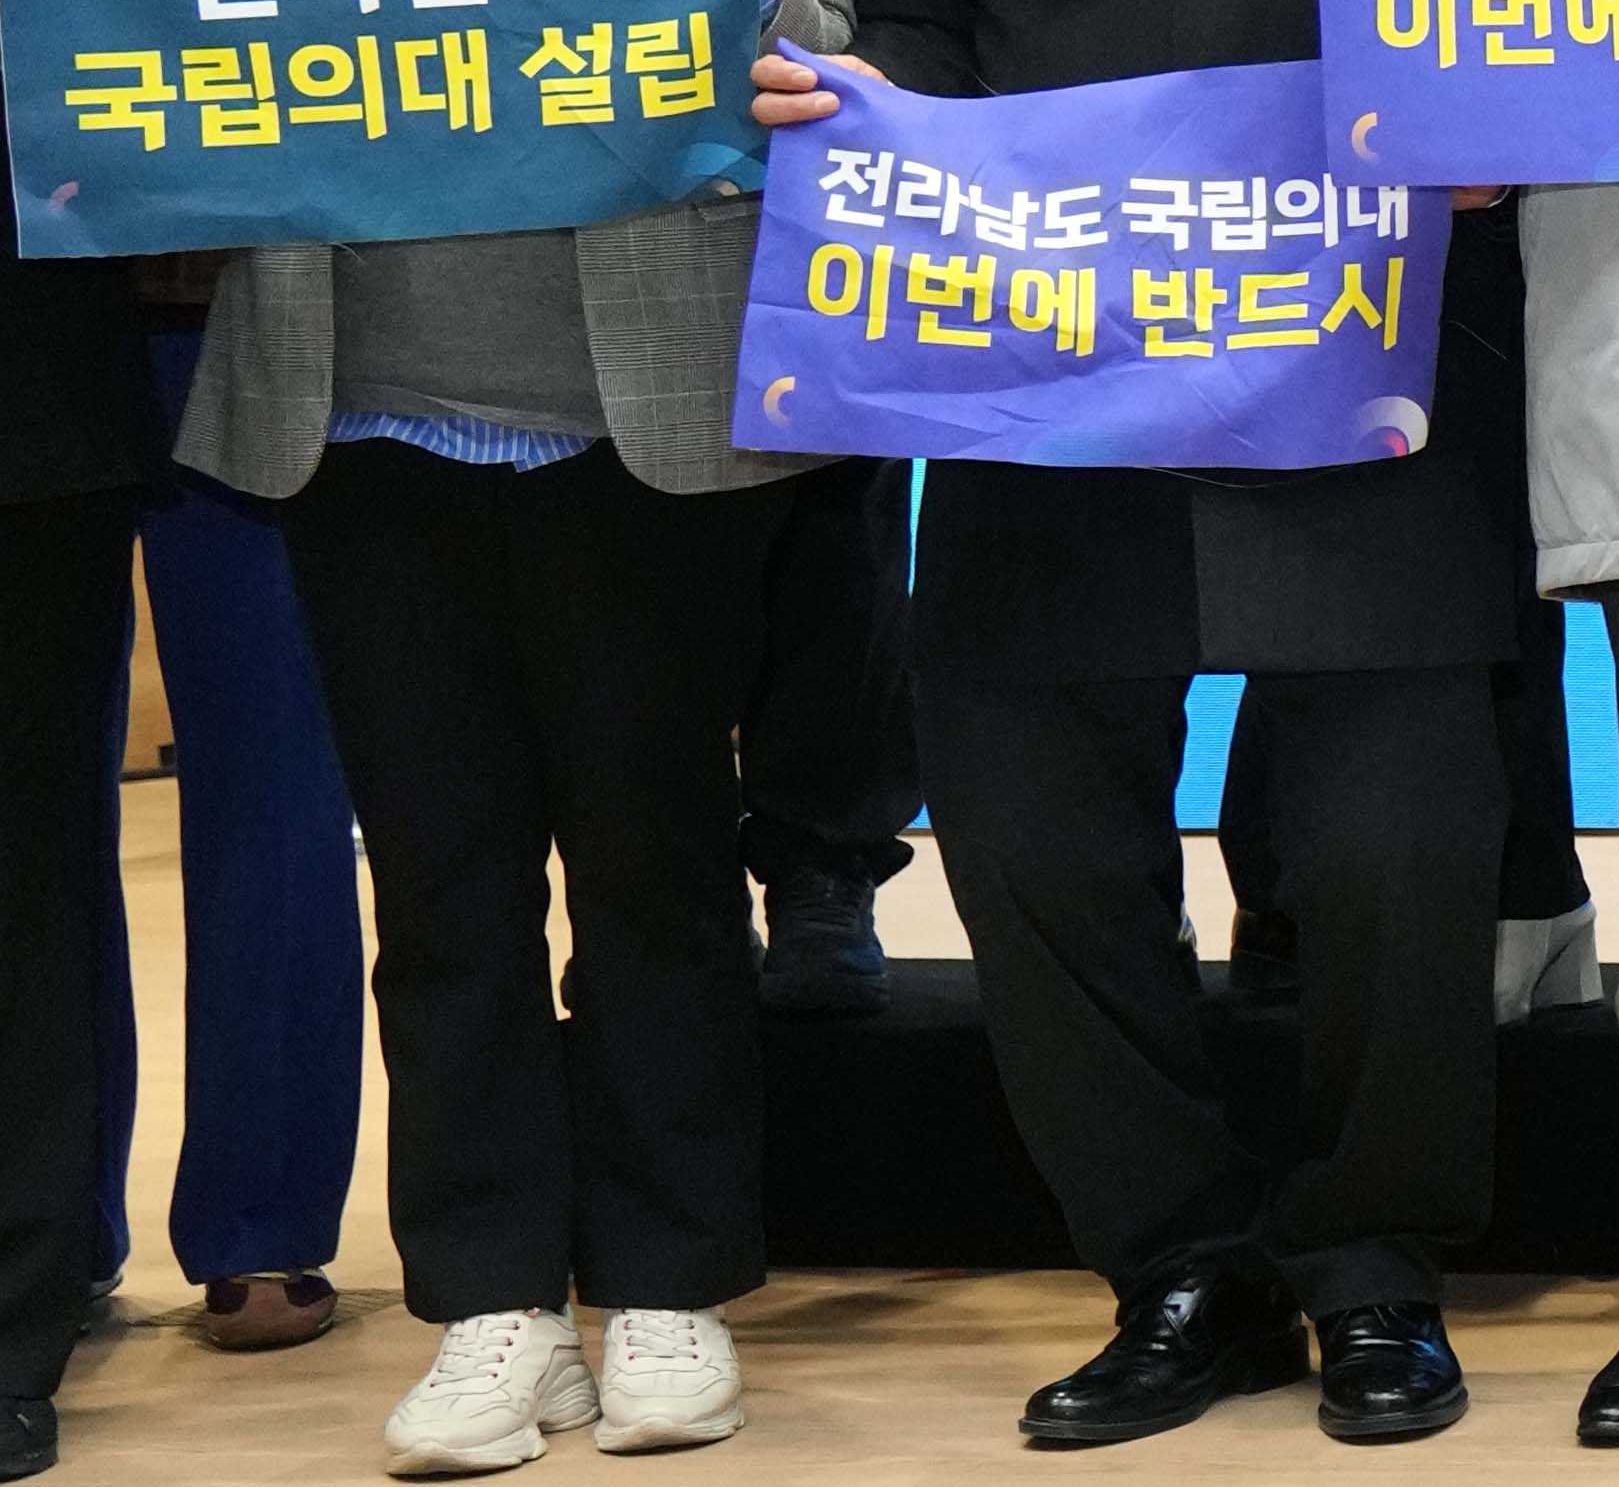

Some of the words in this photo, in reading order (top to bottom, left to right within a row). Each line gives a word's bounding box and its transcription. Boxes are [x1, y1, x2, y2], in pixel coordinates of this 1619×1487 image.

[65, 29, 492, 151] 국립의대
[520, 12, 715, 126] 설립
[817, 147, 1110, 254] 전라남도
[807, 243, 1094, 356] 이번에
[1132, 257, 1404, 356] 반드시
